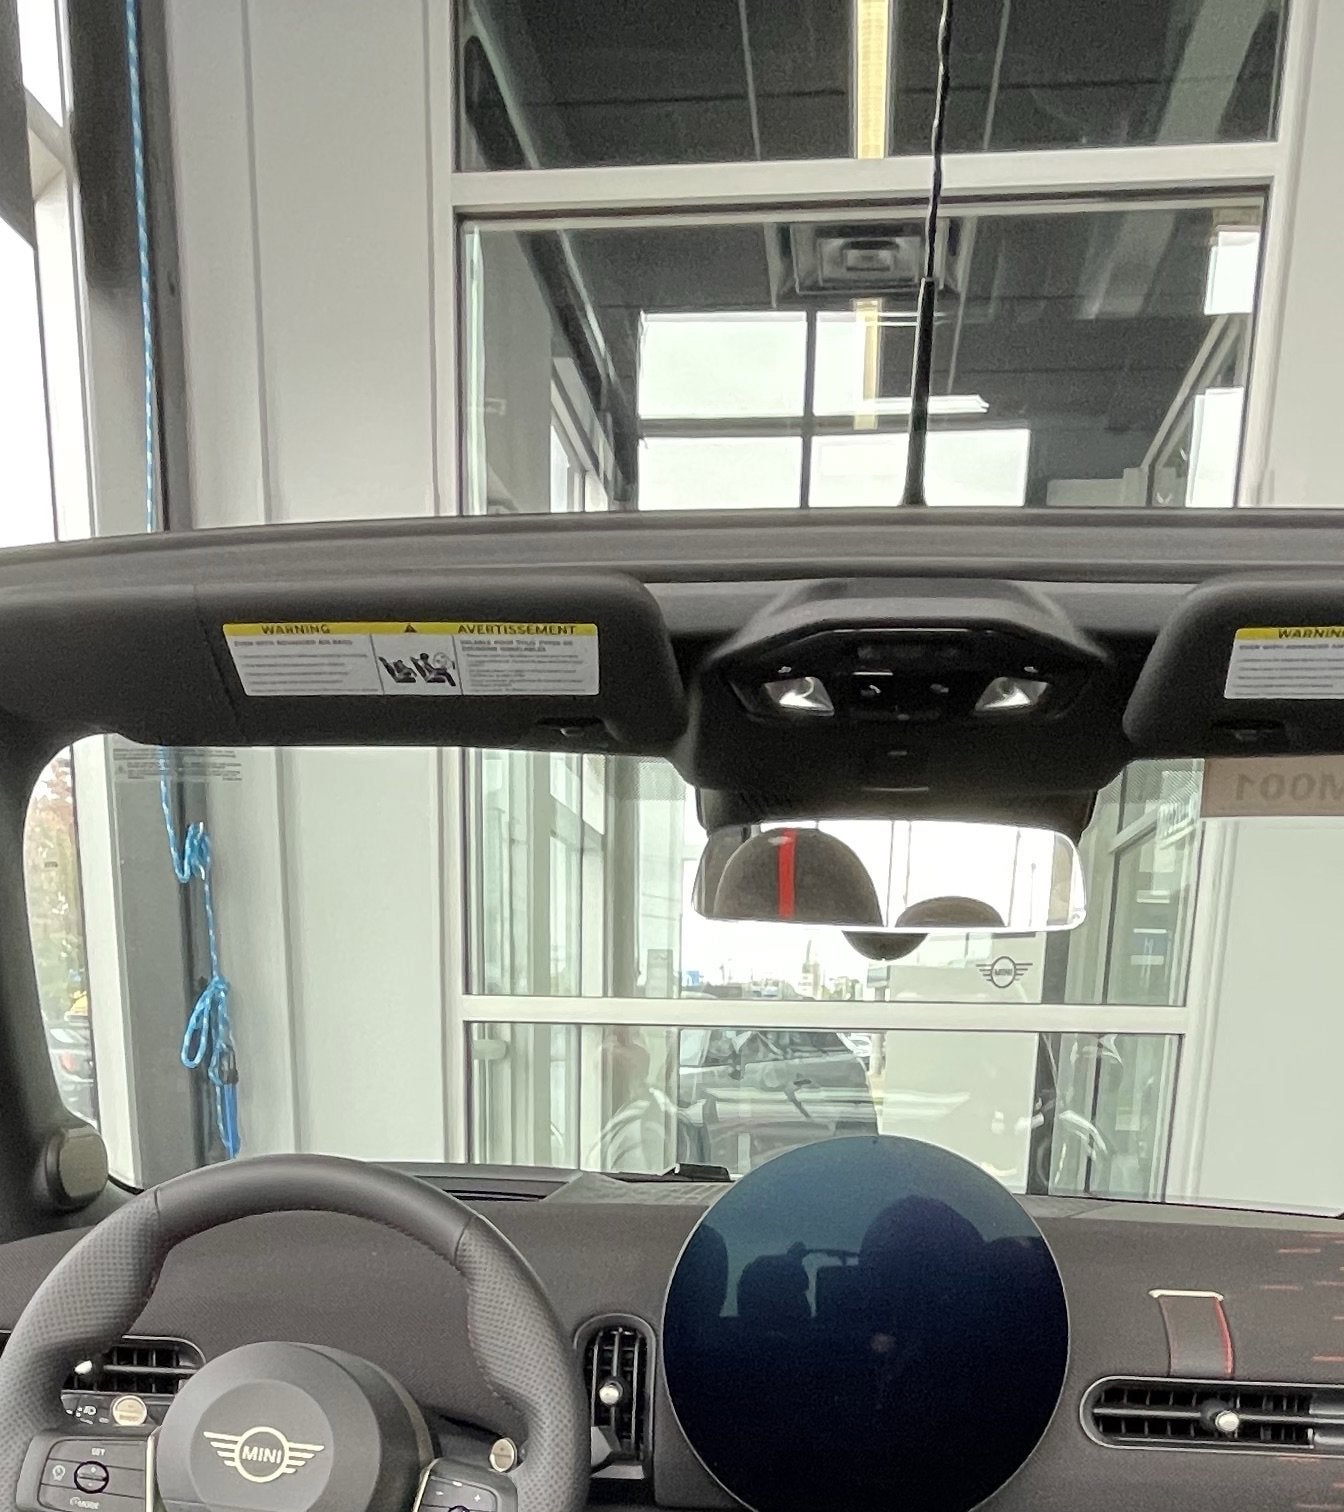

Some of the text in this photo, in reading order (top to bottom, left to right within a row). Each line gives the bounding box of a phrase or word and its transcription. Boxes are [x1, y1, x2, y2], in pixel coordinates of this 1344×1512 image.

[261, 623, 331, 635] WARNING
[457, 624, 577, 636] AVERTISSEMENT
[241, 1445, 282, 1464] MINI
